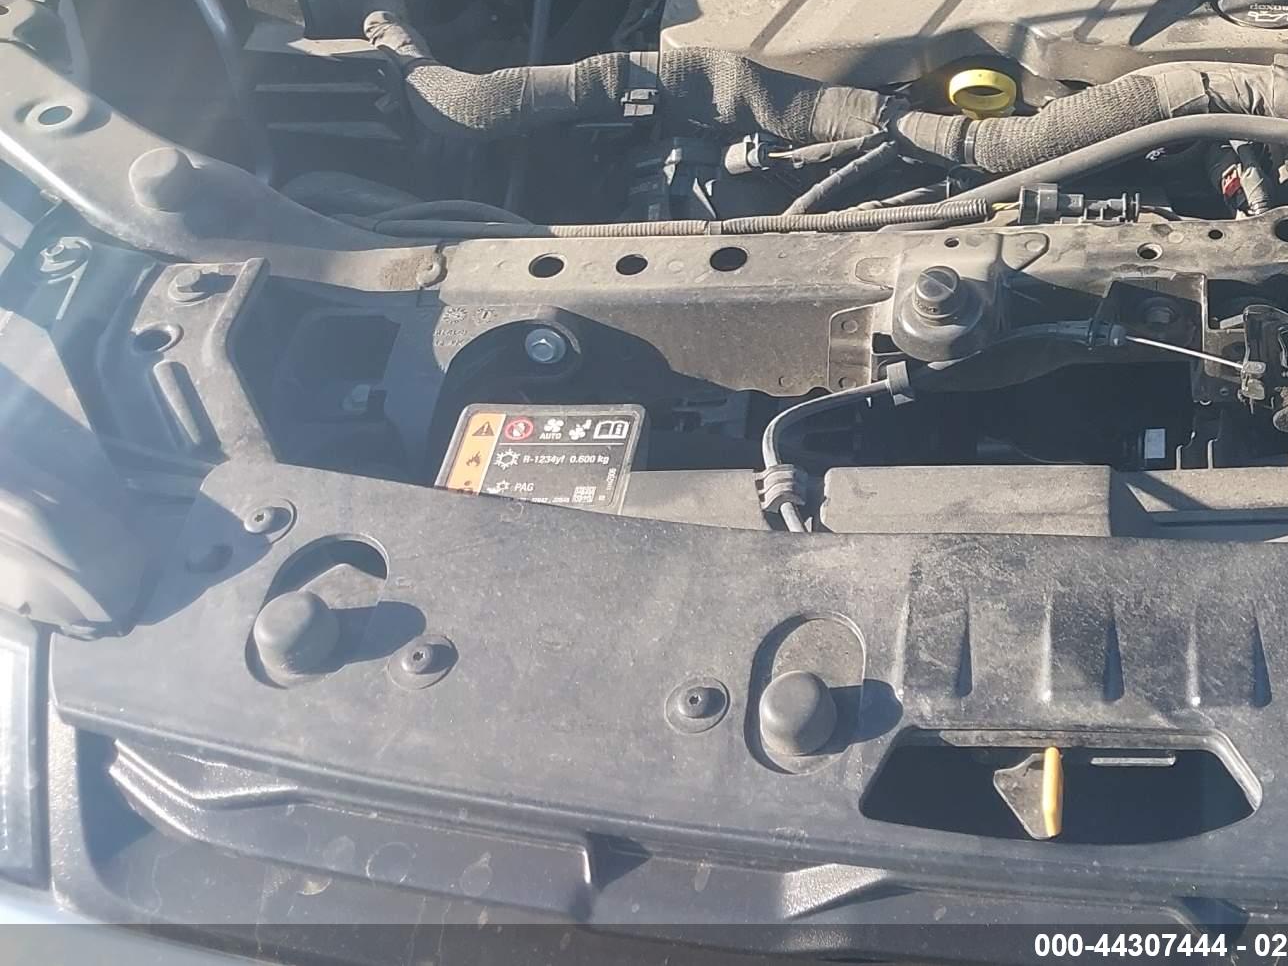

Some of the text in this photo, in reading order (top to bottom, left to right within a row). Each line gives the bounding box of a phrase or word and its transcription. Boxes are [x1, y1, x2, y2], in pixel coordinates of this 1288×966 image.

[539, 432, 562, 440] AUTO
[523, 455, 610, 465] R-1234yf 0.600 kg
[514, 482, 535, 492] PAG
